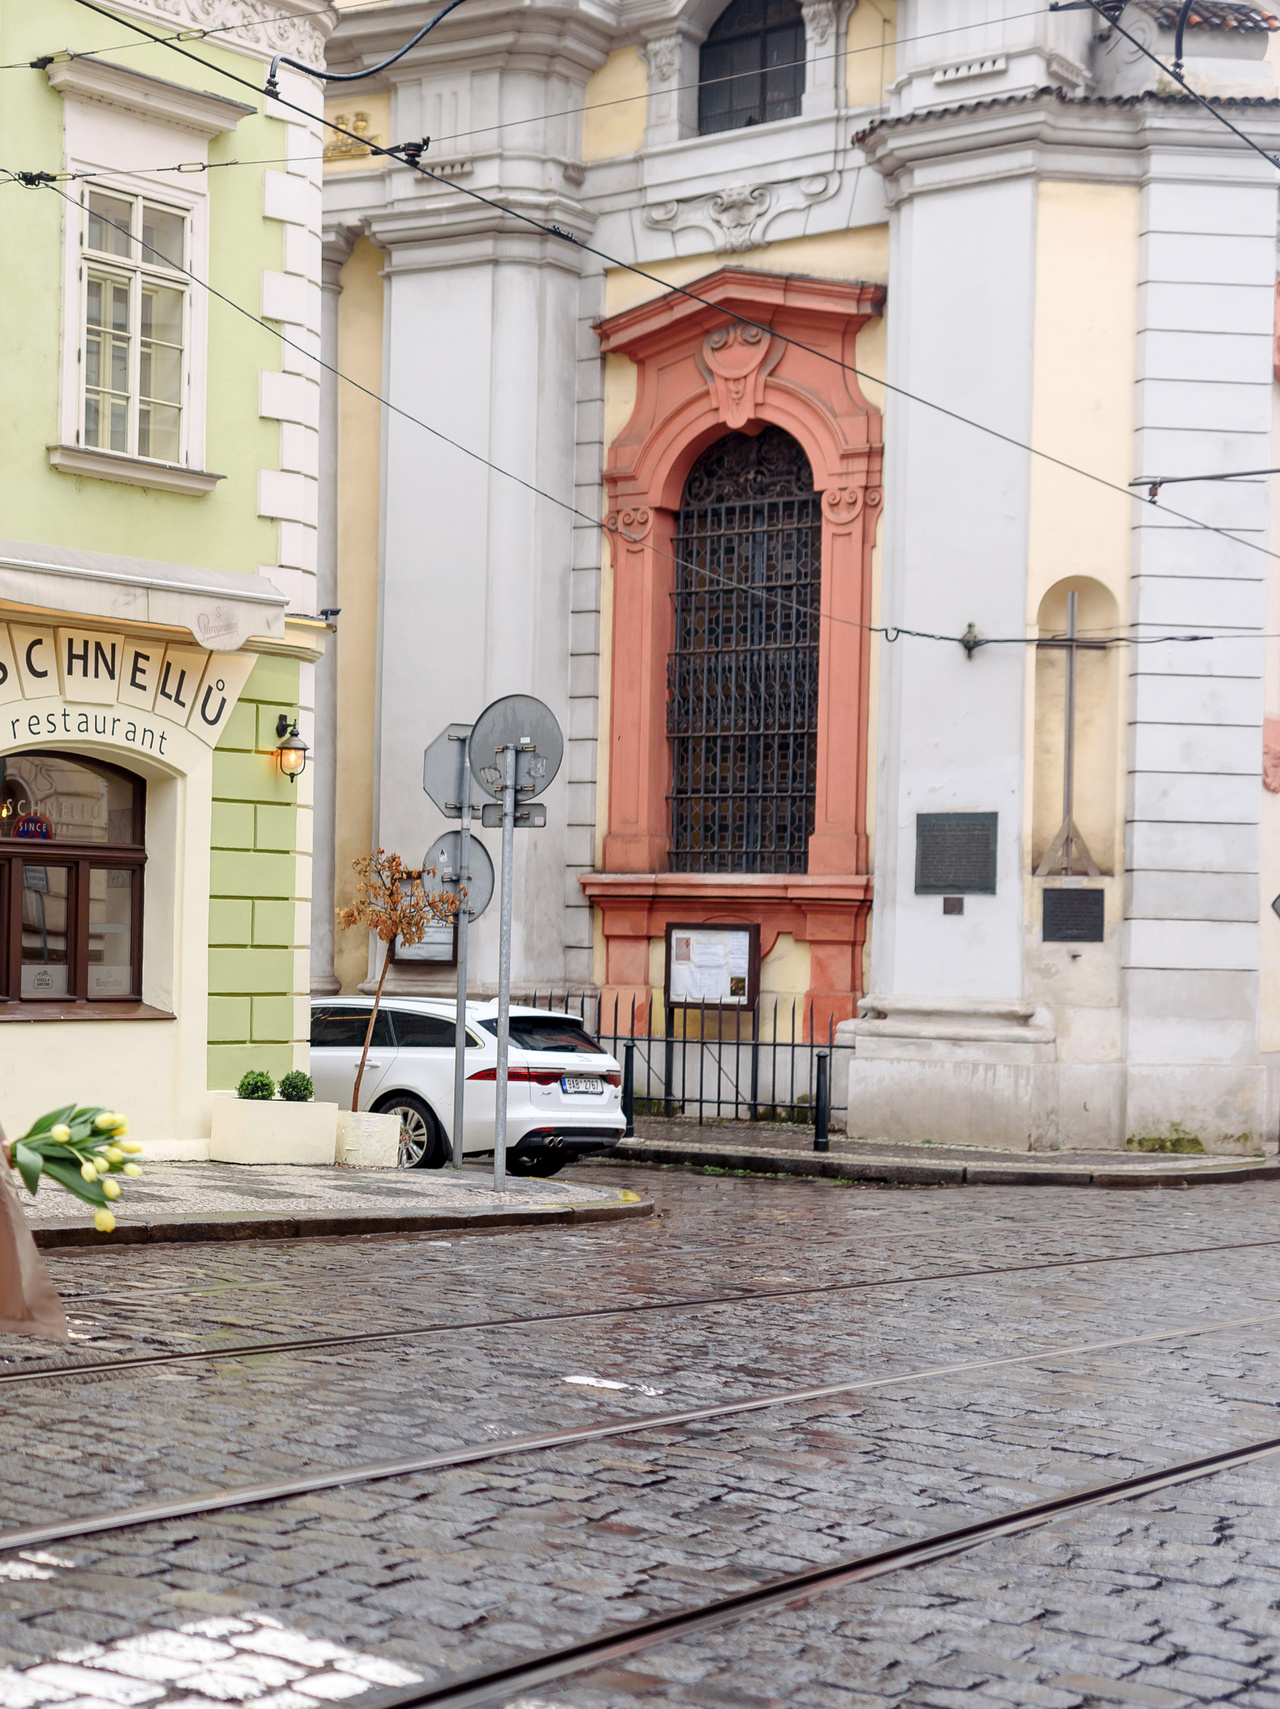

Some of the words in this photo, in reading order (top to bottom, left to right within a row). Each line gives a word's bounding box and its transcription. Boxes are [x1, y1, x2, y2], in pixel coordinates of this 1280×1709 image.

[10, 707, 168, 756] restaurant
[18, 822, 47, 833] SINCE
[51, 824, 73, 834] 1787
